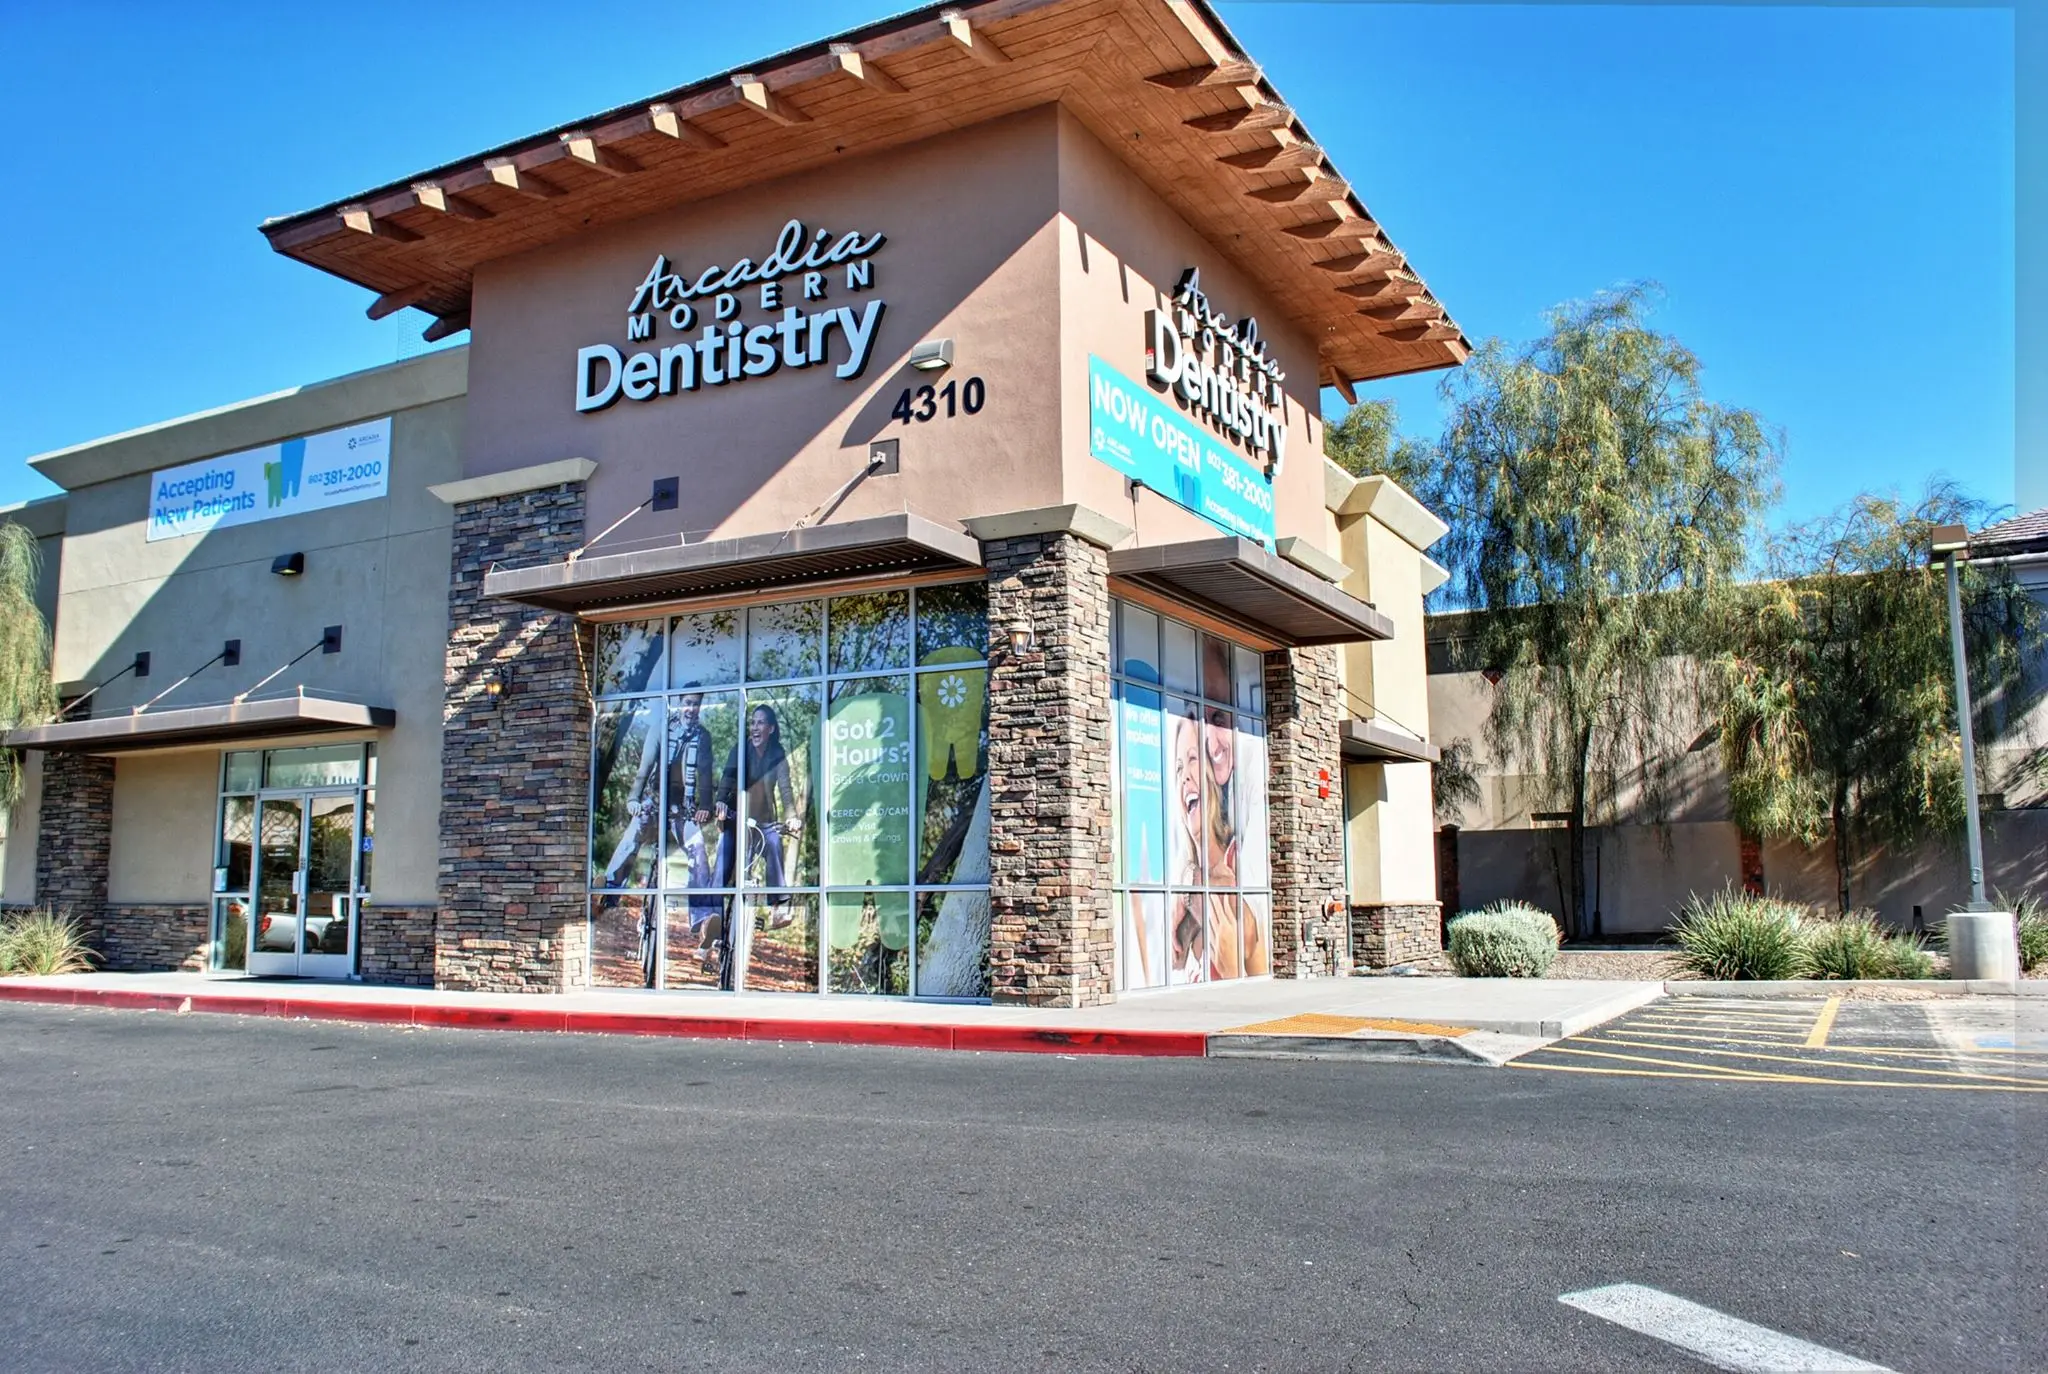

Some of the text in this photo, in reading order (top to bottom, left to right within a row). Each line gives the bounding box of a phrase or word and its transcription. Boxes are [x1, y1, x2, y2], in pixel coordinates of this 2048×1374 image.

[628, 218, 885, 312] Arcadia
[628, 259, 875, 341] MODERN
[576, 299, 886, 413] Dentistry
[891, 376, 986, 425] 4310
[1147, 308, 1287, 477] Dentistry
[1094, 373, 1200, 473] NOW OPEN
[154, 491, 255, 526] New Patients
[157, 469, 235, 501] Accepting
[832, 716, 895, 741] Got 2
[832, 741, 910, 766] Hours?
[868, 771, 909, 785] Crown
